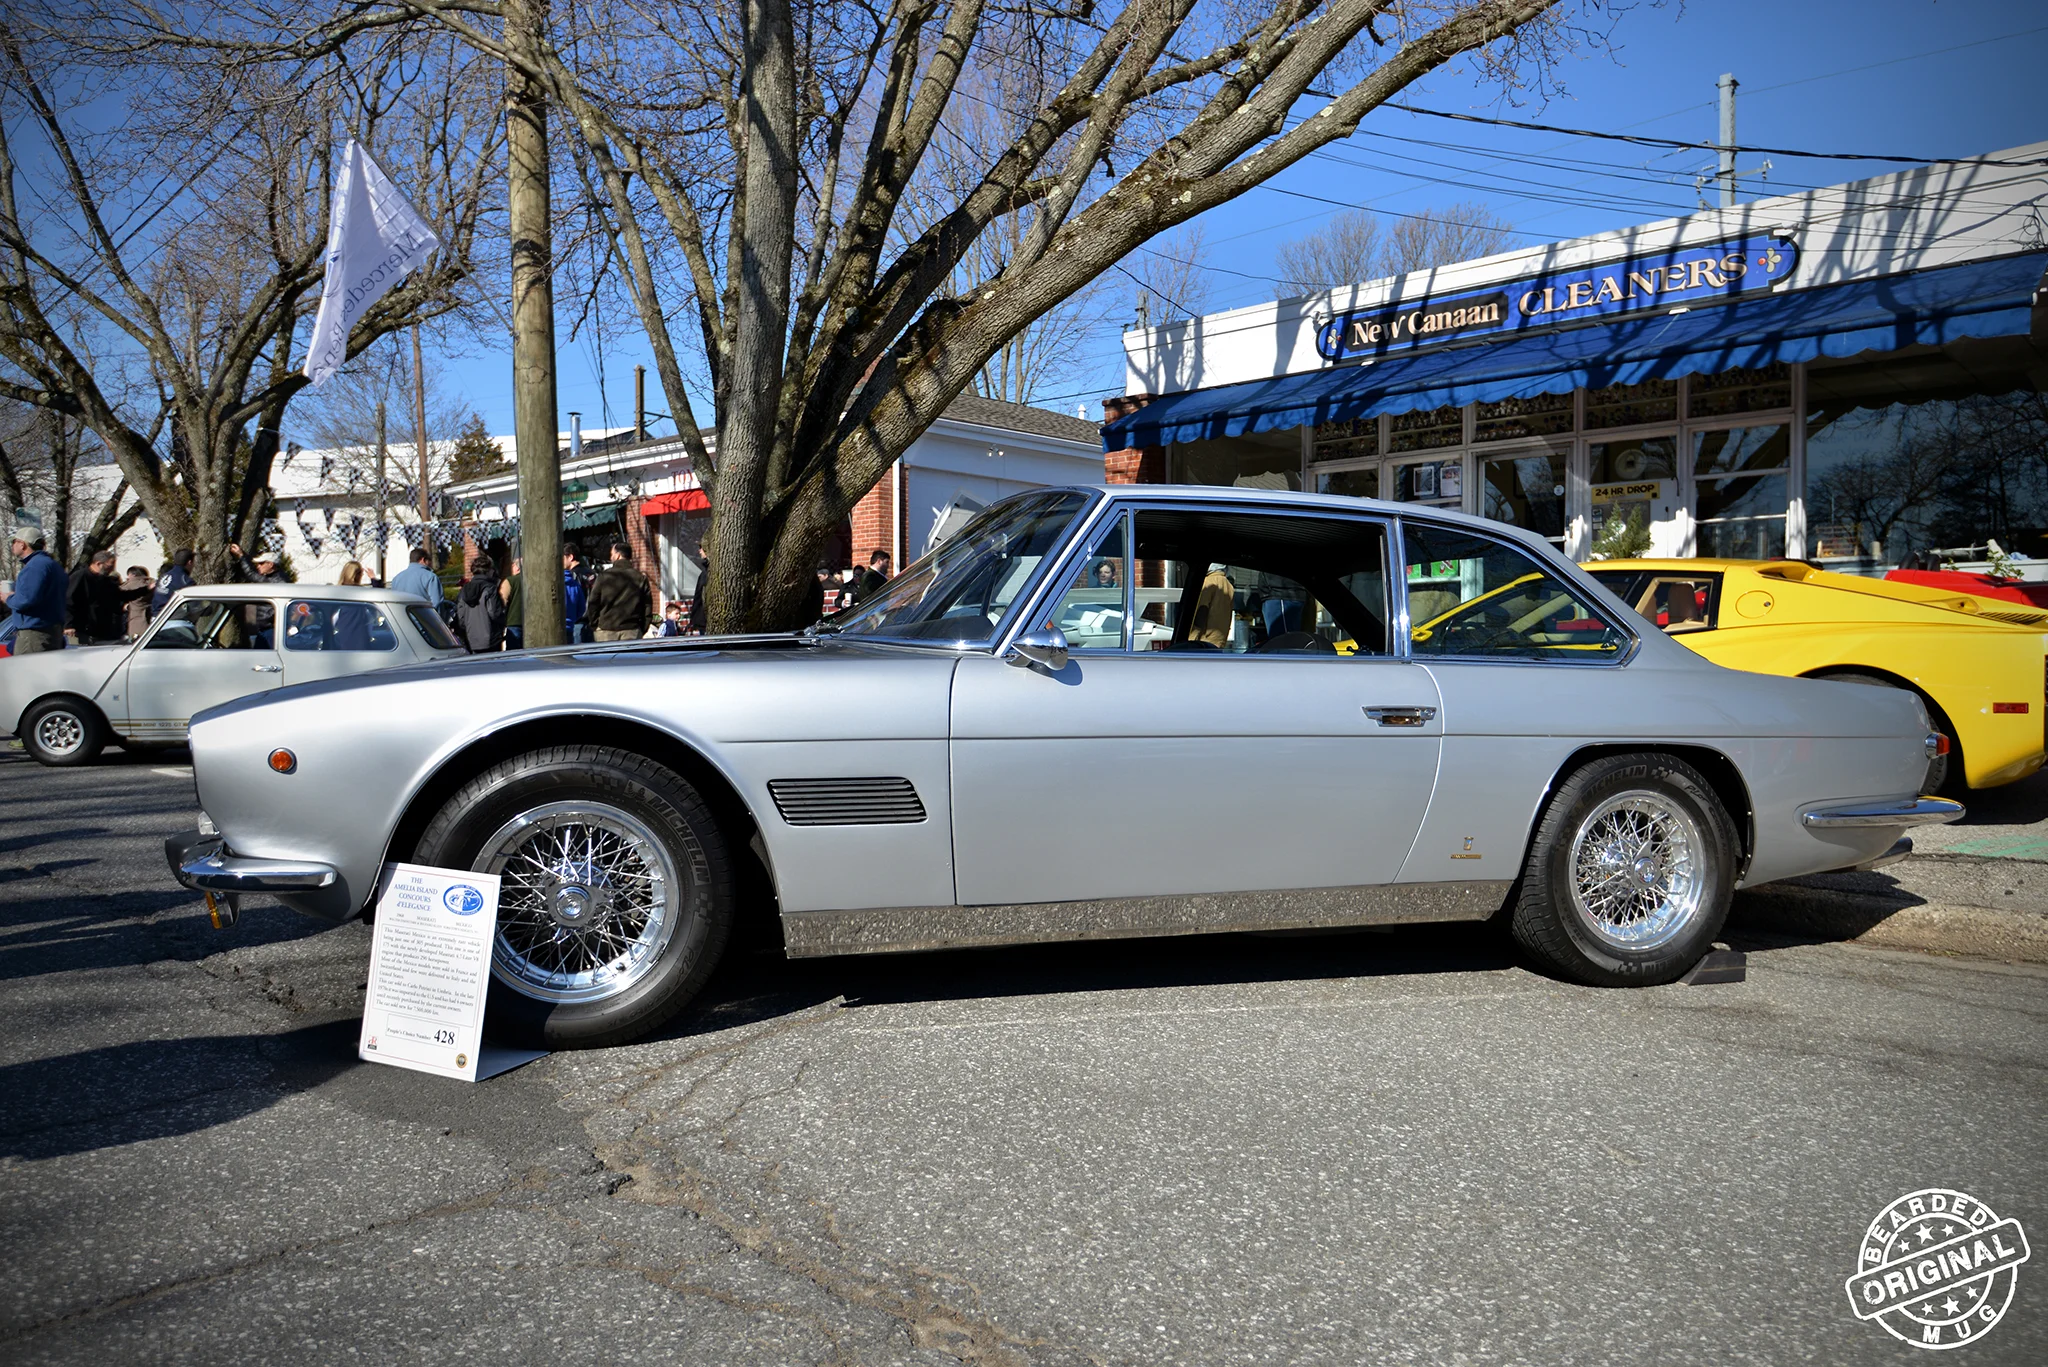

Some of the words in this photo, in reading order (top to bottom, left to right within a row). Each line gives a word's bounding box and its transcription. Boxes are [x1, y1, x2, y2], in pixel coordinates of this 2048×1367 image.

[1407, 301, 1500, 336] Canaan
[1518, 252, 1749, 318] CLEANERS
[1595, 488, 1609, 497] 24
[1610, 486, 1624, 496] HR
[1627, 484, 1655, 494] DROP
[1581, 765, 1646, 806] MICHELIN
[648, 795, 710, 883] MICHELIN
[394, 884, 415, 892] AMELIA
[416, 887, 438, 895] ISLAND
[399, 893, 431, 903] CONCOURS
[434, 1028, 455, 1045] 428
